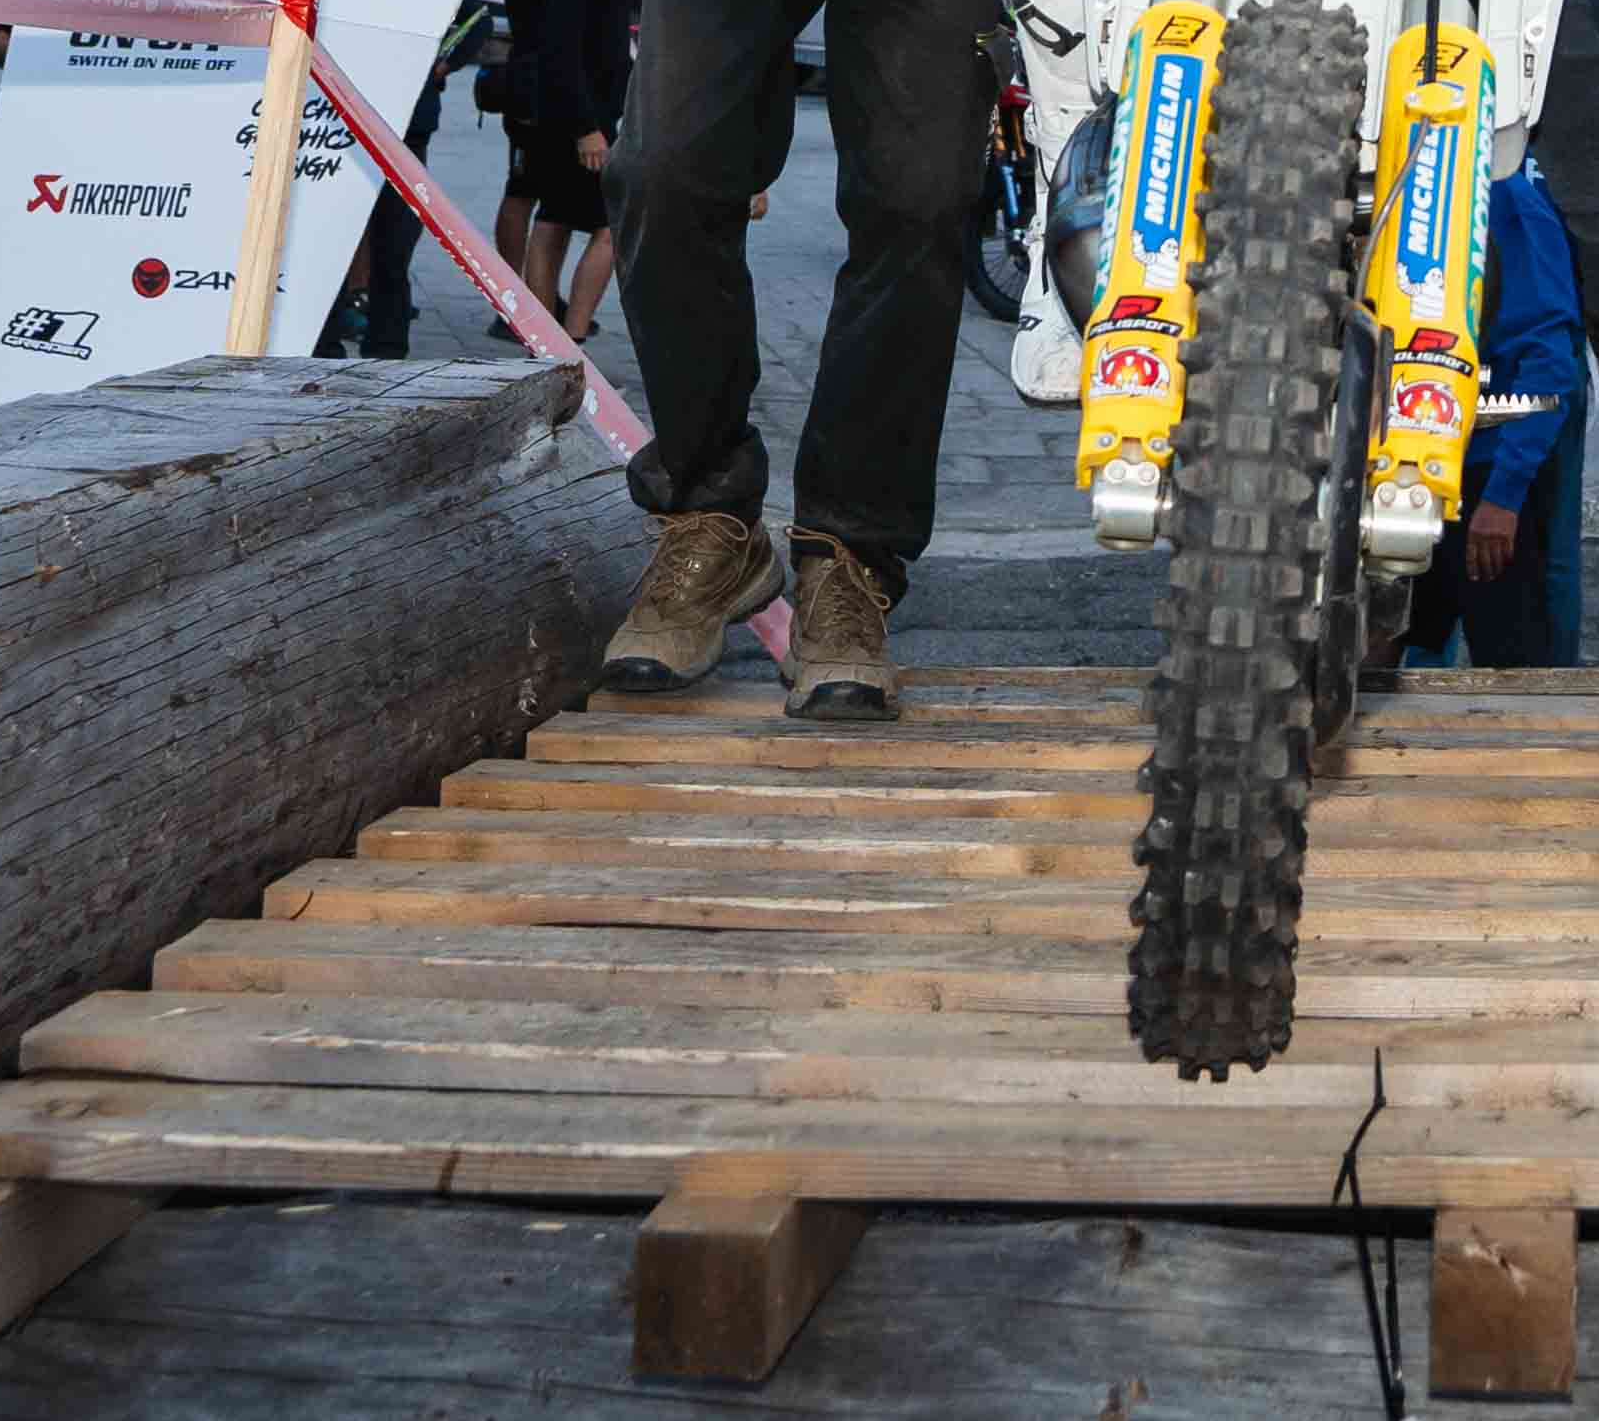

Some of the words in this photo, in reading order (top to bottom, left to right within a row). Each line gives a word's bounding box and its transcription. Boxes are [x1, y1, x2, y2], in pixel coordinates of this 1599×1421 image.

[68, 54, 129, 69] SWITCH
[133, 55, 158, 70] ON
[161, 56, 202, 70] RIDE
[205, 57, 237, 71] OFF
[1143, 61, 1185, 226] MICHELIN
[70, 182, 192, 219] AKRAPOVIČ
[10, 308, 99, 346] #1
[1088, 318, 1183, 341] POLISPORT
[1395, 351, 1473, 376] OLISPORT
